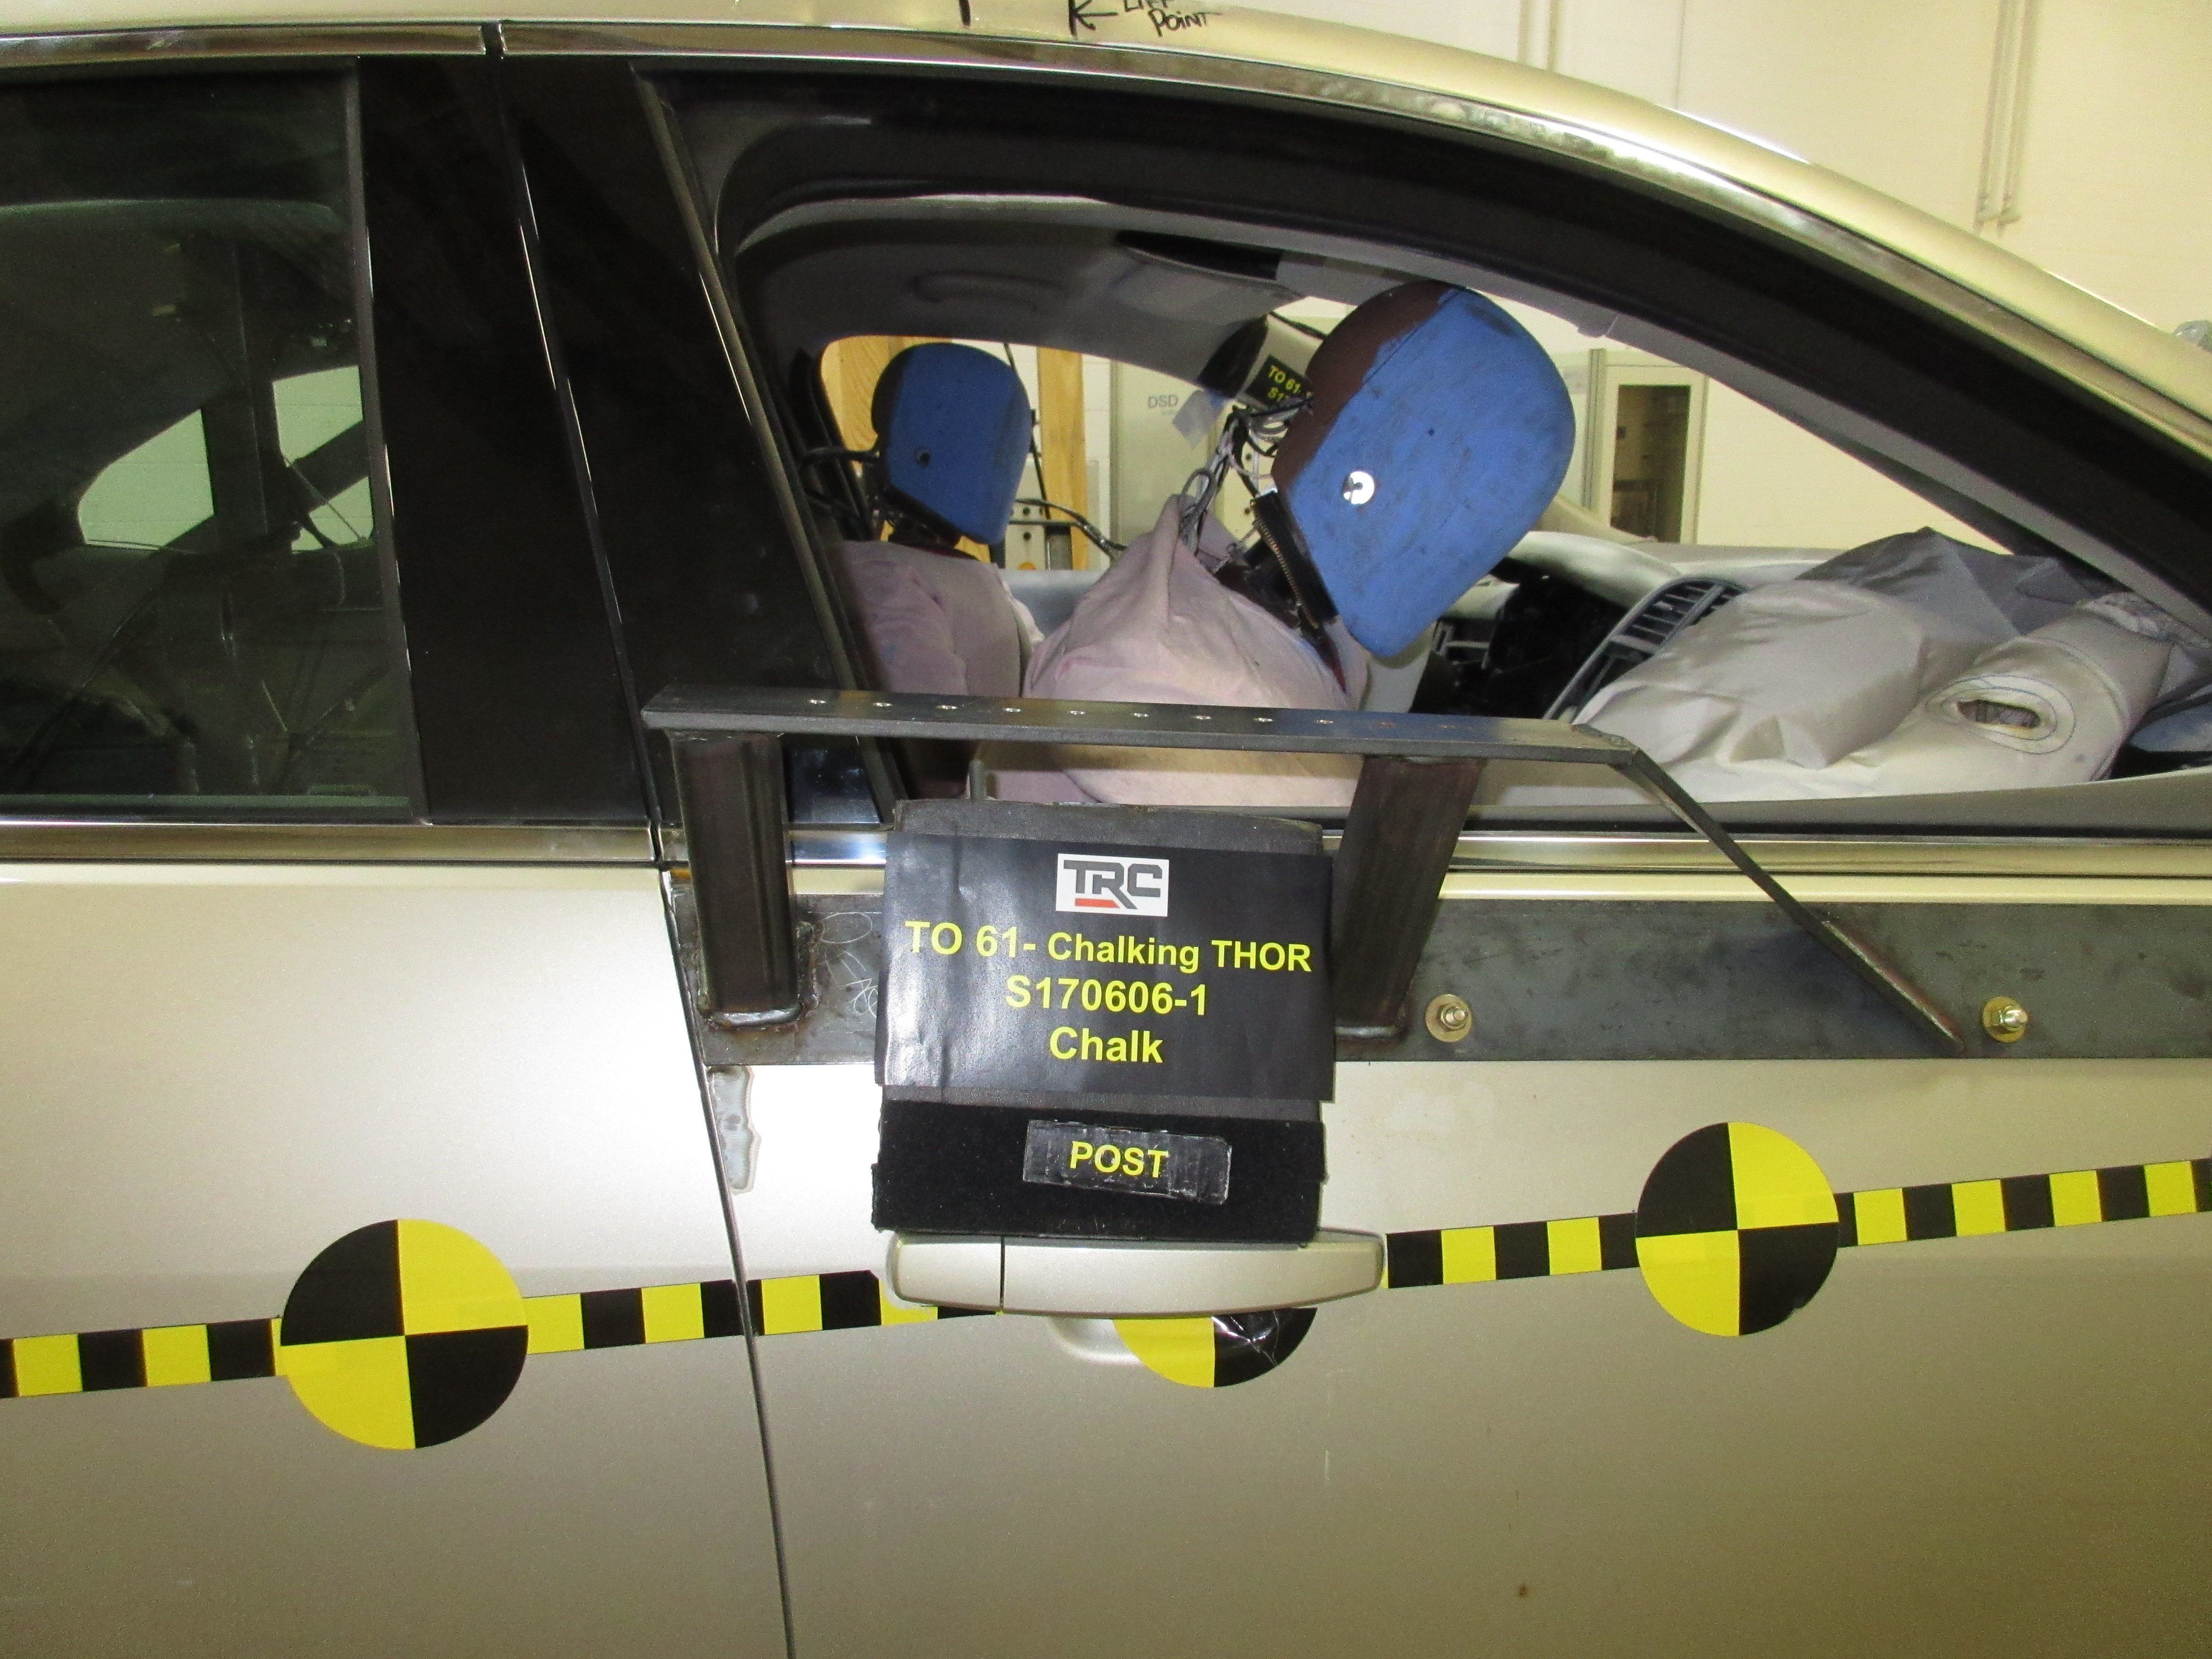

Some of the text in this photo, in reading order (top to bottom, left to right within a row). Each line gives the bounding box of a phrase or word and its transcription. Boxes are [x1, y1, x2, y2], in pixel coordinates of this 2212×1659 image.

[1269, 365, 1286, 384] TO
[1064, 860, 1162, 909] TRC
[904, 921, 1312, 974] TO 61- Chalking THOR
[1006, 974, 1206, 1015] S170606-1
[1050, 1026, 1164, 1063] Chalk
[1070, 1141, 1168, 1178] POST
